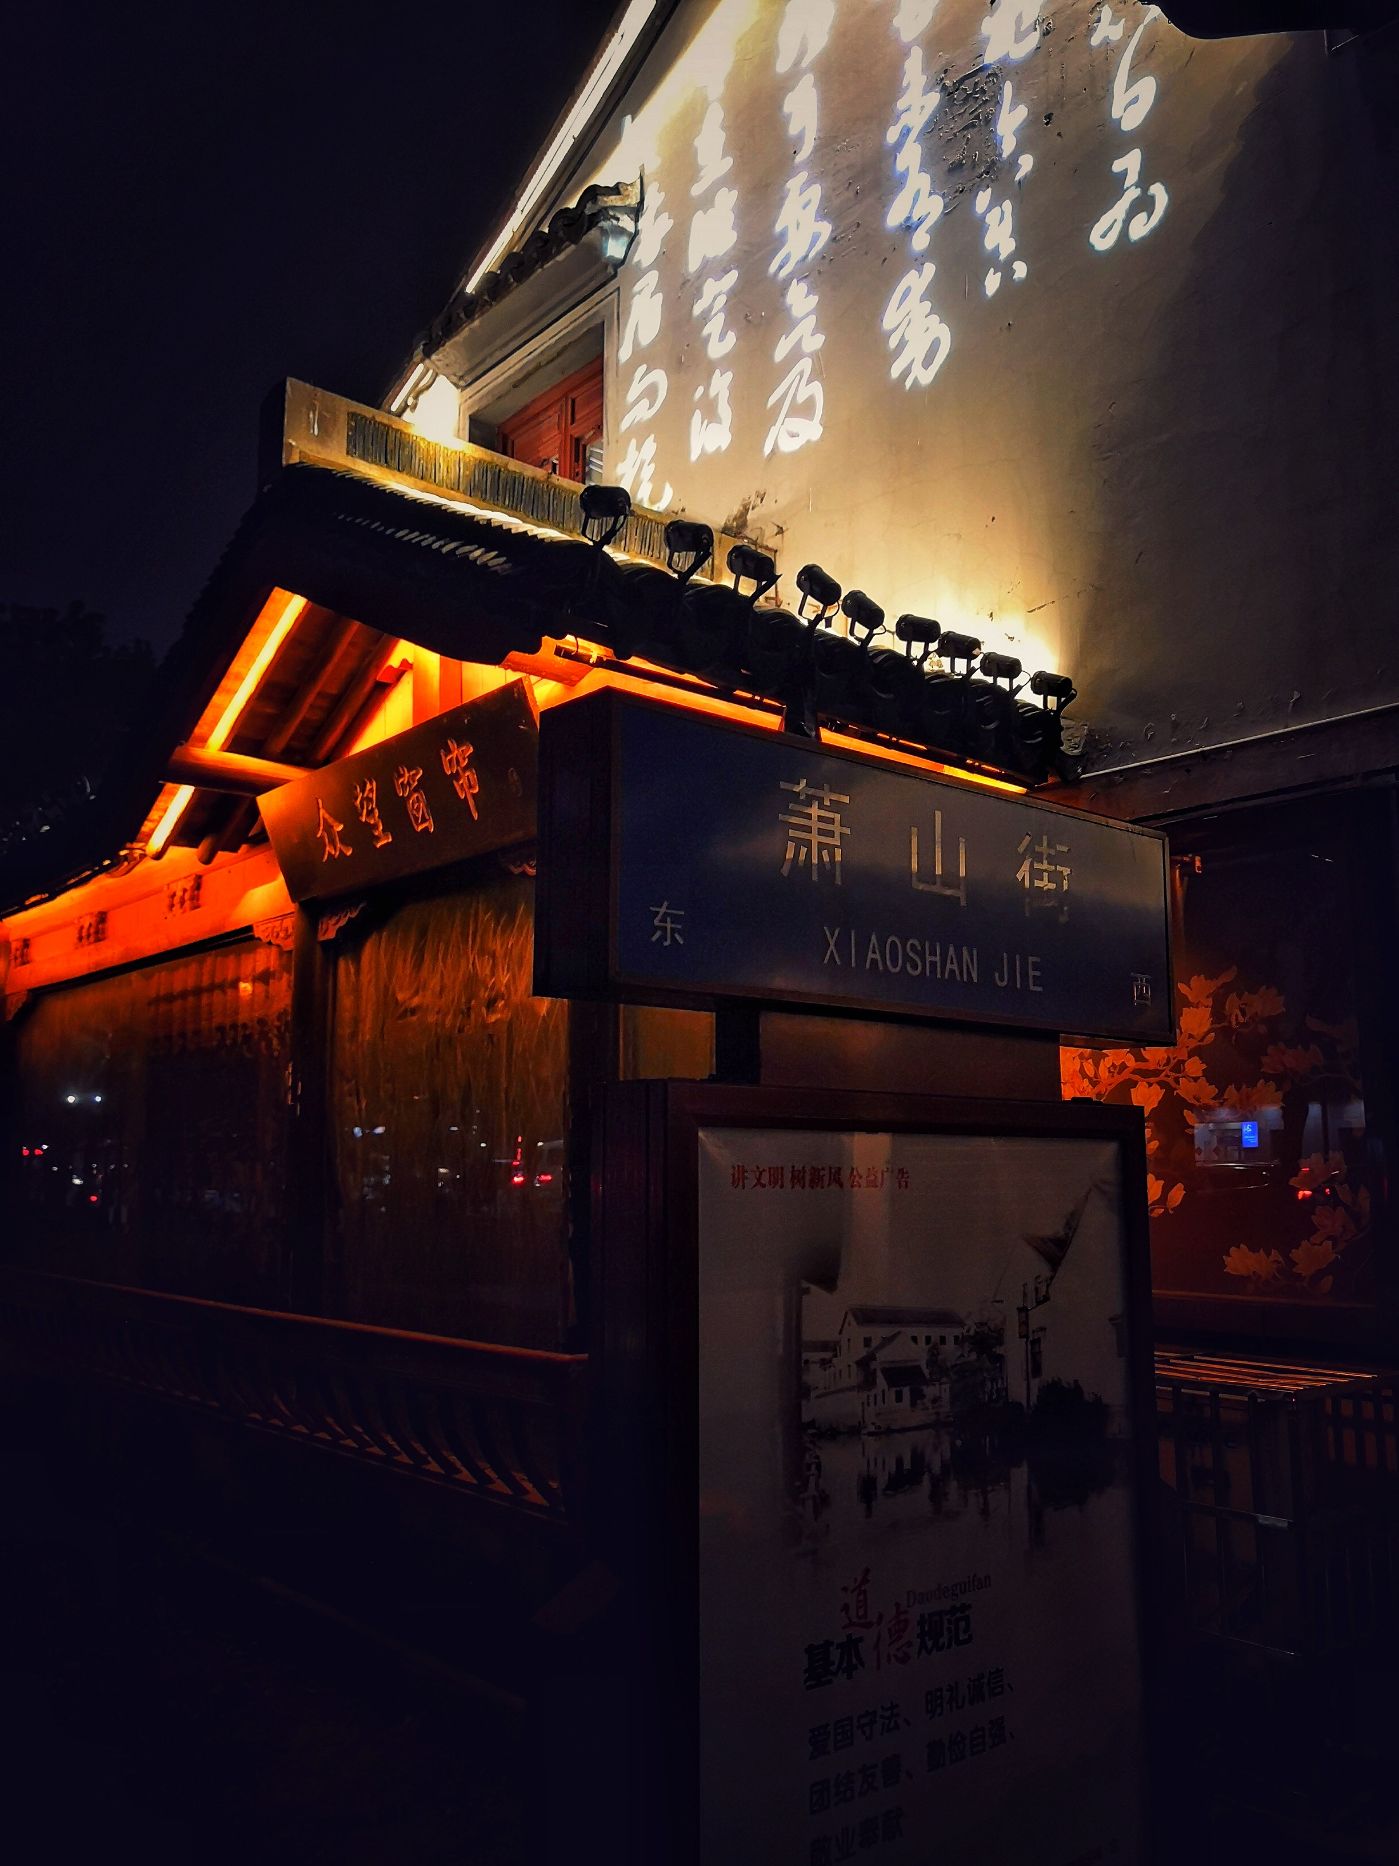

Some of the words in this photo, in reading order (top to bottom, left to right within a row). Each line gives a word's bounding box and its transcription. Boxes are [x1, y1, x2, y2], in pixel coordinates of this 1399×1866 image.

[779, 778, 1071, 922] 萧山街
[650, 900, 686, 947] 东
[823, 925, 979, 983] XIAOSHAN
[994, 955, 1044, 993] JIE
[1131, 972, 1154, 1007] 西
